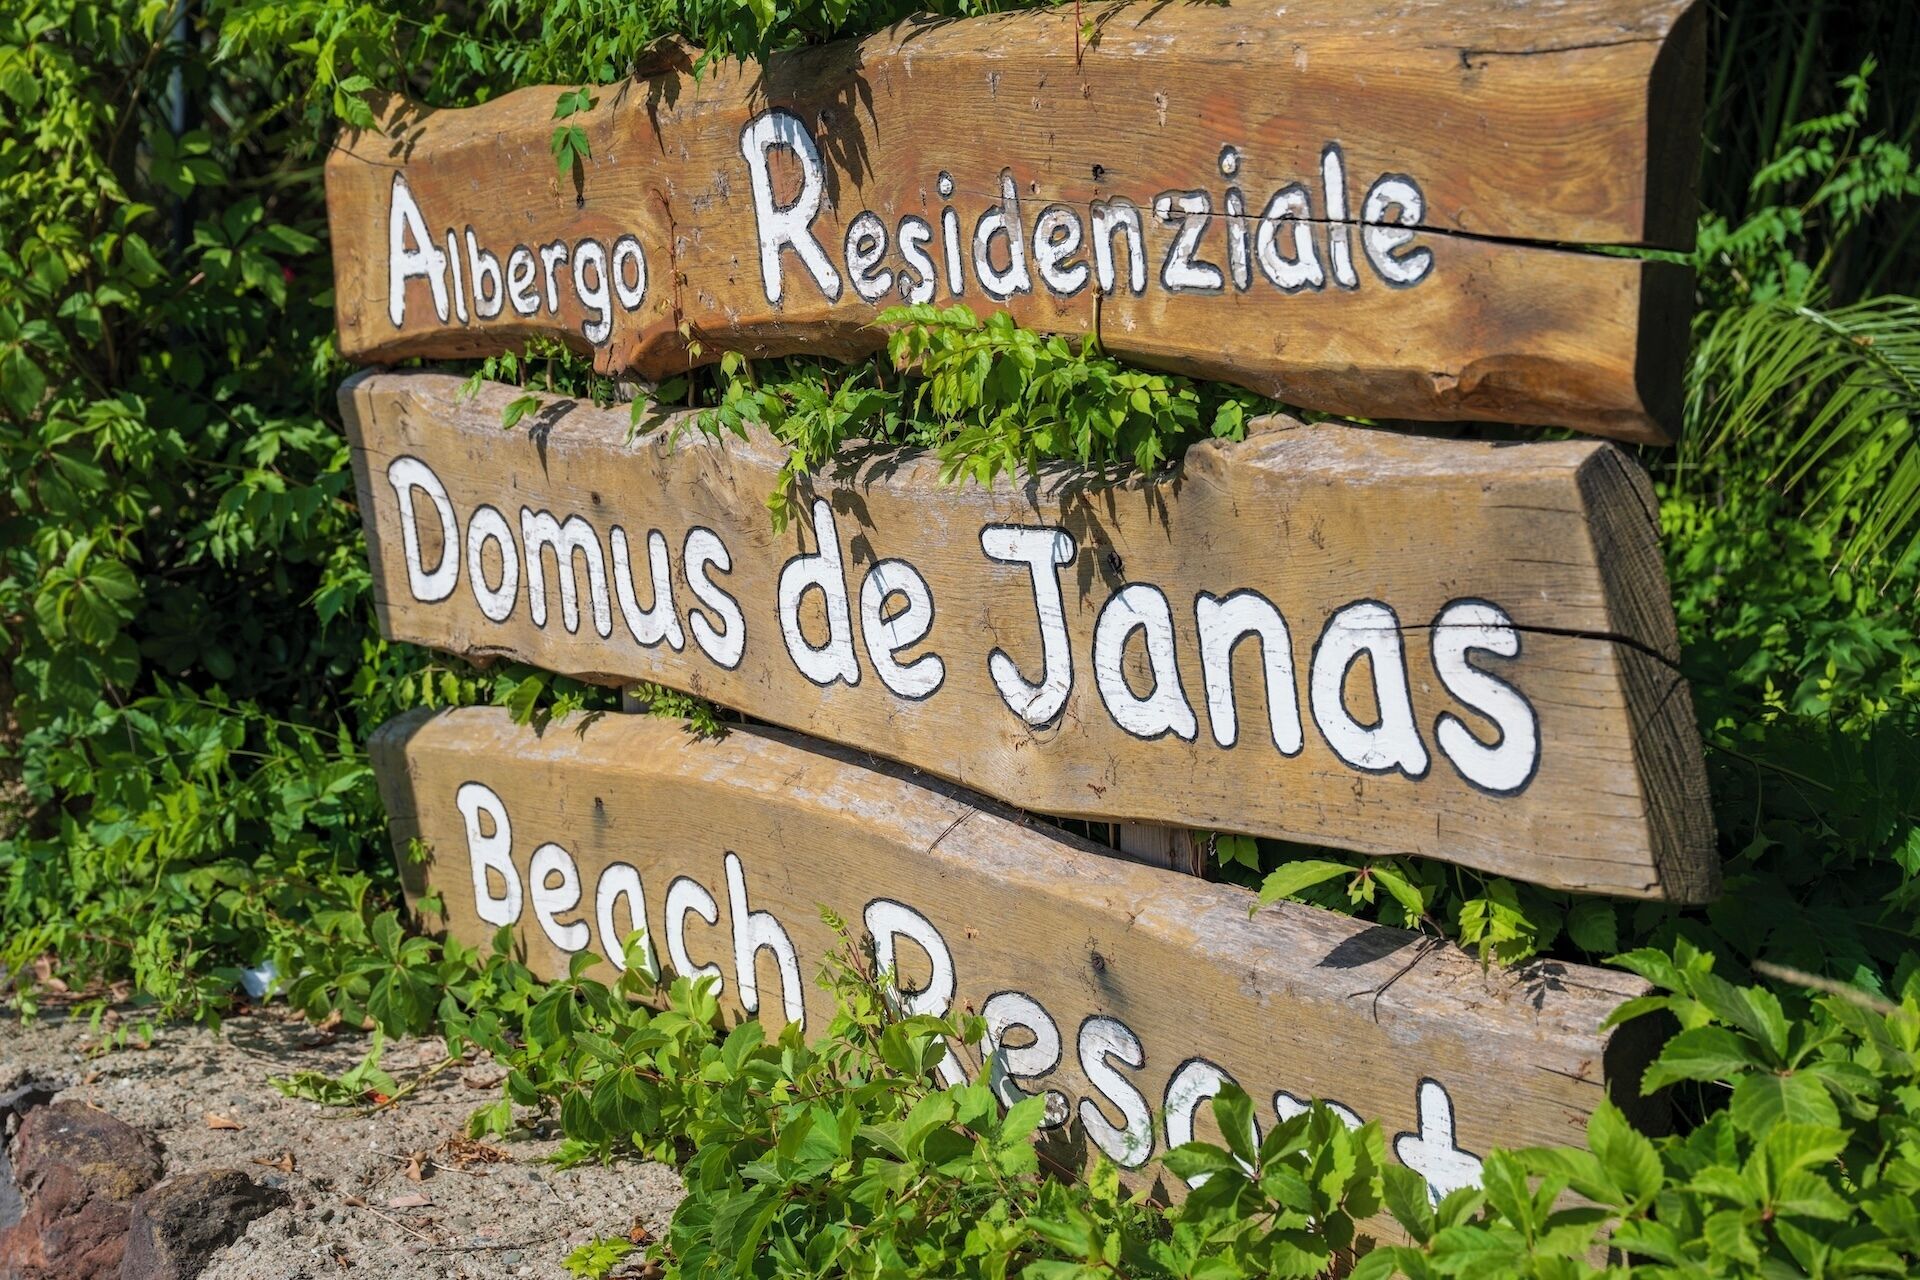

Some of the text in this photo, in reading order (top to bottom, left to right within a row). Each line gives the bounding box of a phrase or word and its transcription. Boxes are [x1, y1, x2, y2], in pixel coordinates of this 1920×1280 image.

[387, 106, 1434, 347] Albergo Residenziale
[386, 454, 1542, 798] Domus de Janas
[455, 780, 807, 1034] Beach
